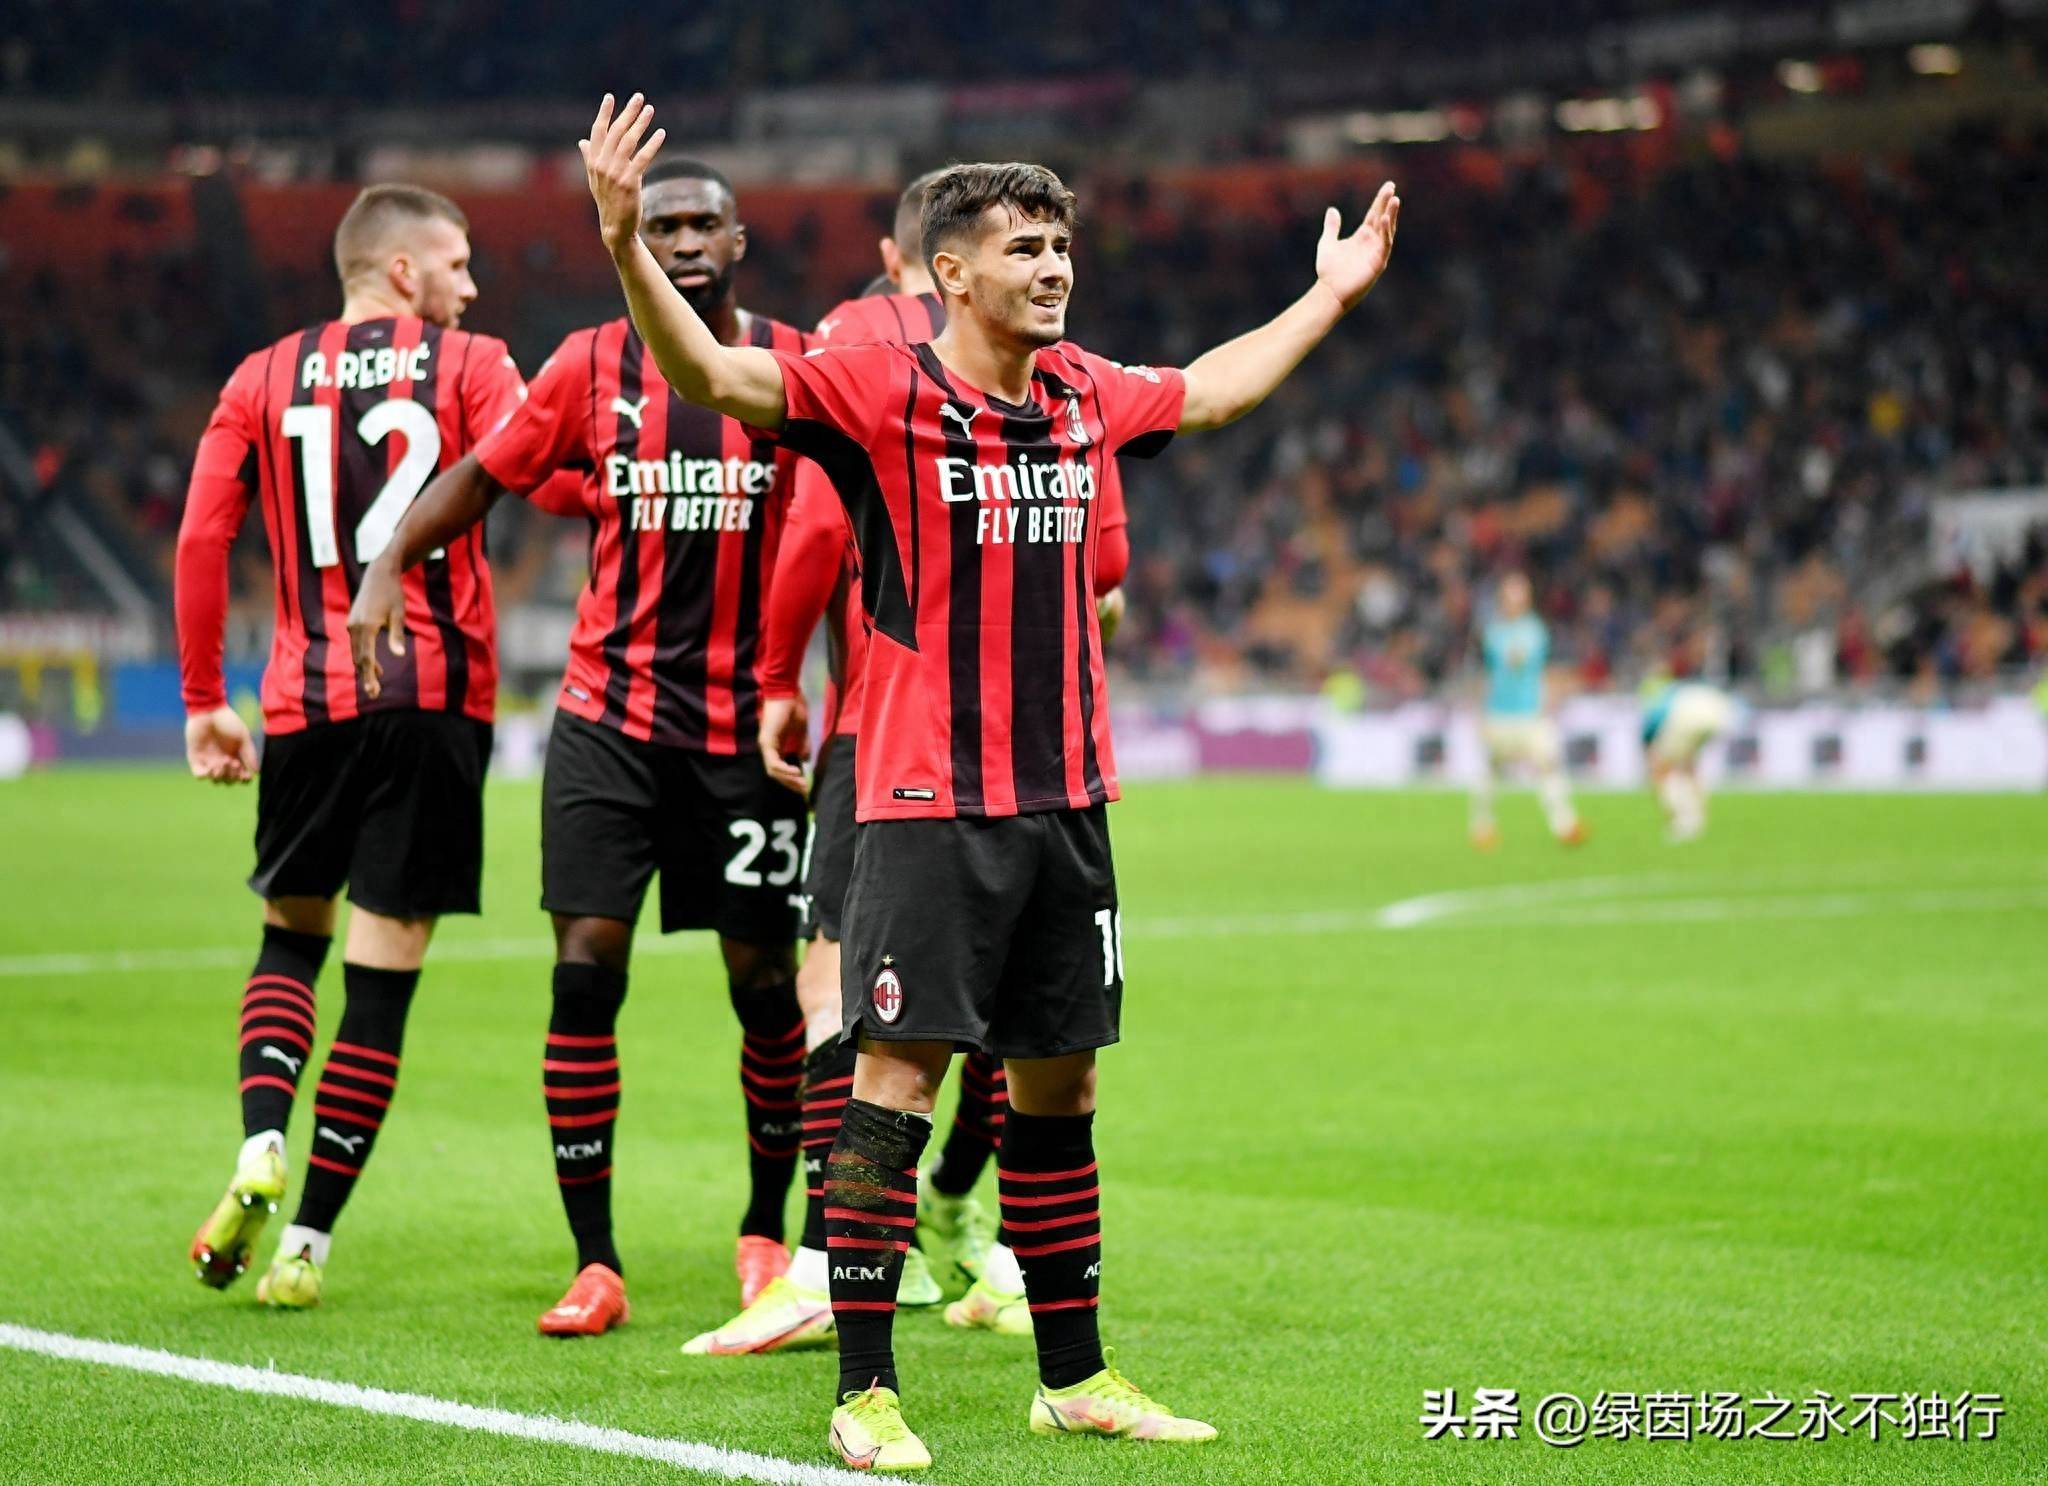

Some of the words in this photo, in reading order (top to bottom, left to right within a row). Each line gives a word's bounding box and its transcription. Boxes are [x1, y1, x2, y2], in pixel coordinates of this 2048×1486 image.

[281, 398, 446, 568] 12
[605, 450, 779, 497] Emirates
[935, 453, 1096, 502] Emirates
[631, 496, 668, 532] FLY
[671, 496, 753, 532] BETTER
[976, 507, 1020, 545] FLY
[1027, 506, 1085, 544] BETTER
[724, 819, 799, 887] 23
[556, 1139, 602, 1160] ACM
[832, 1266, 886, 1281] ACM
